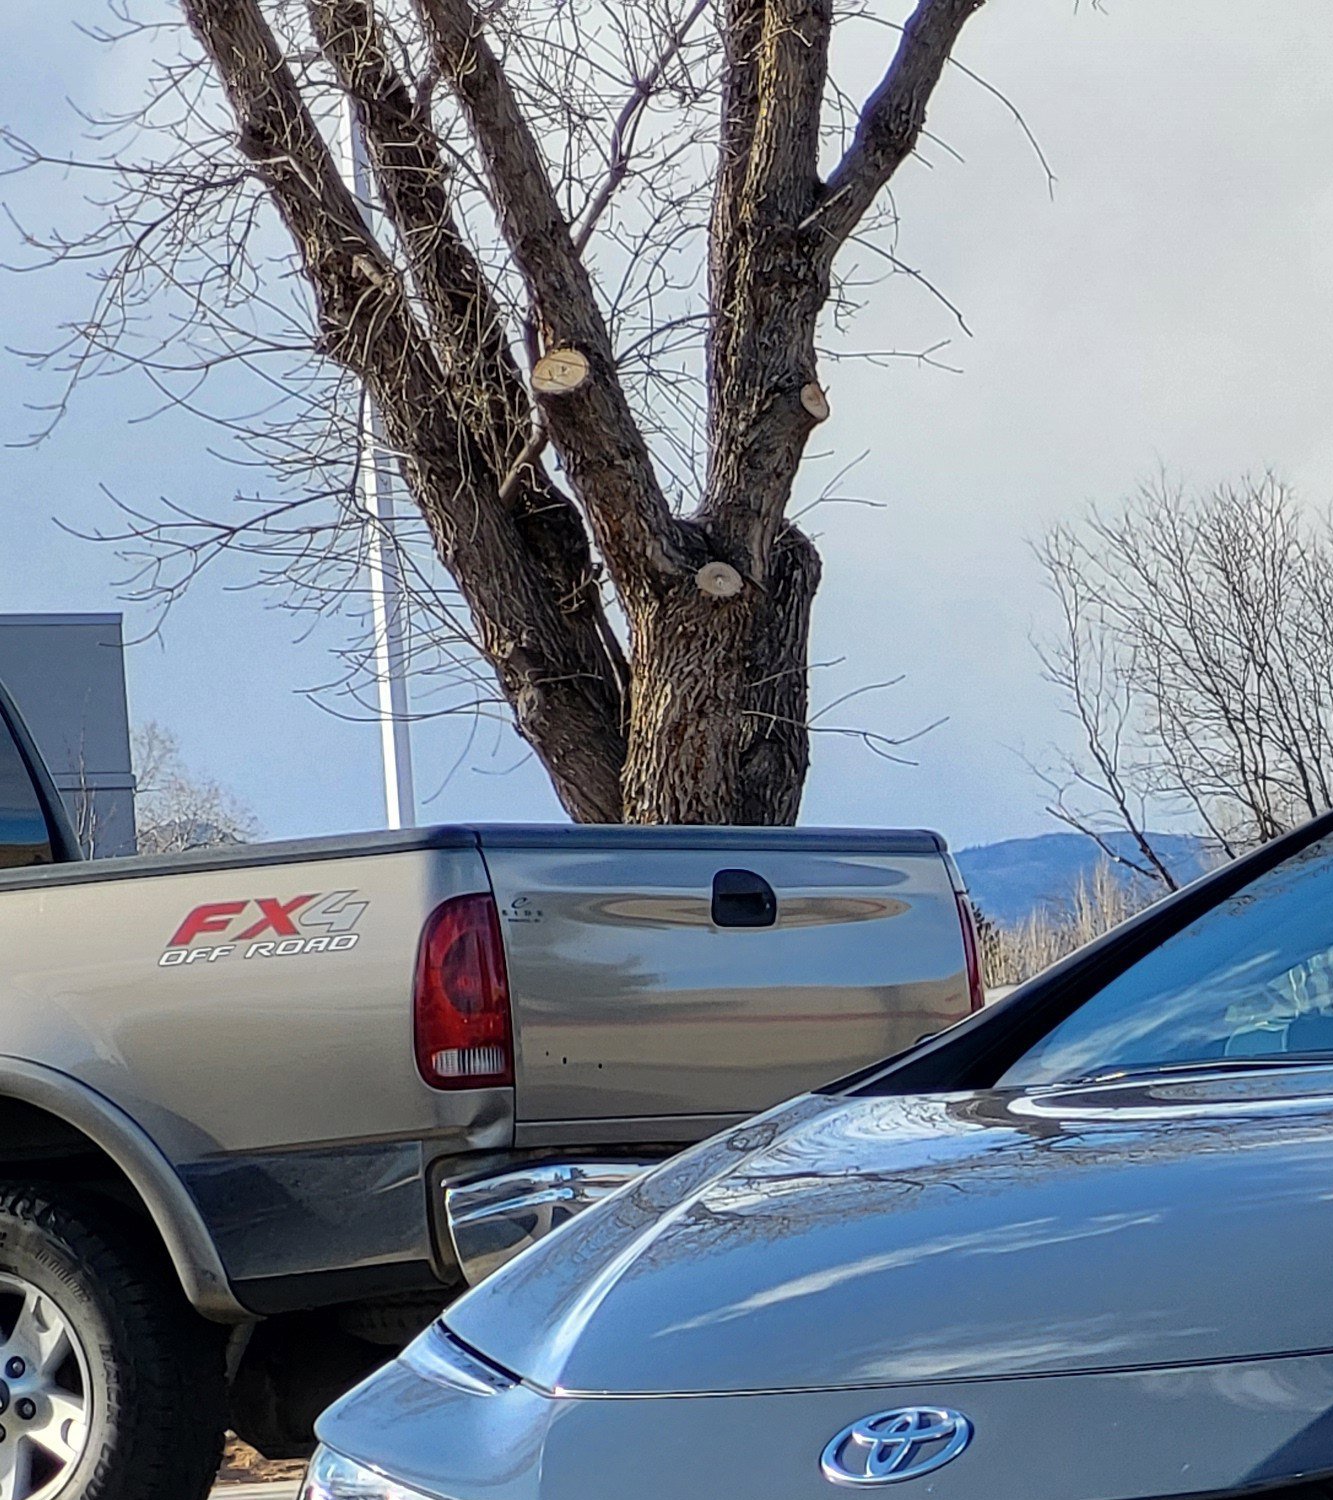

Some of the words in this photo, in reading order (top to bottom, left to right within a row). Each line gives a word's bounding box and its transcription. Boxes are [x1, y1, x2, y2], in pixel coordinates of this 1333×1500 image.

[167, 889, 370, 948] FX4
[158, 944, 236, 967] OFF
[244, 934, 360, 959] ROAD
